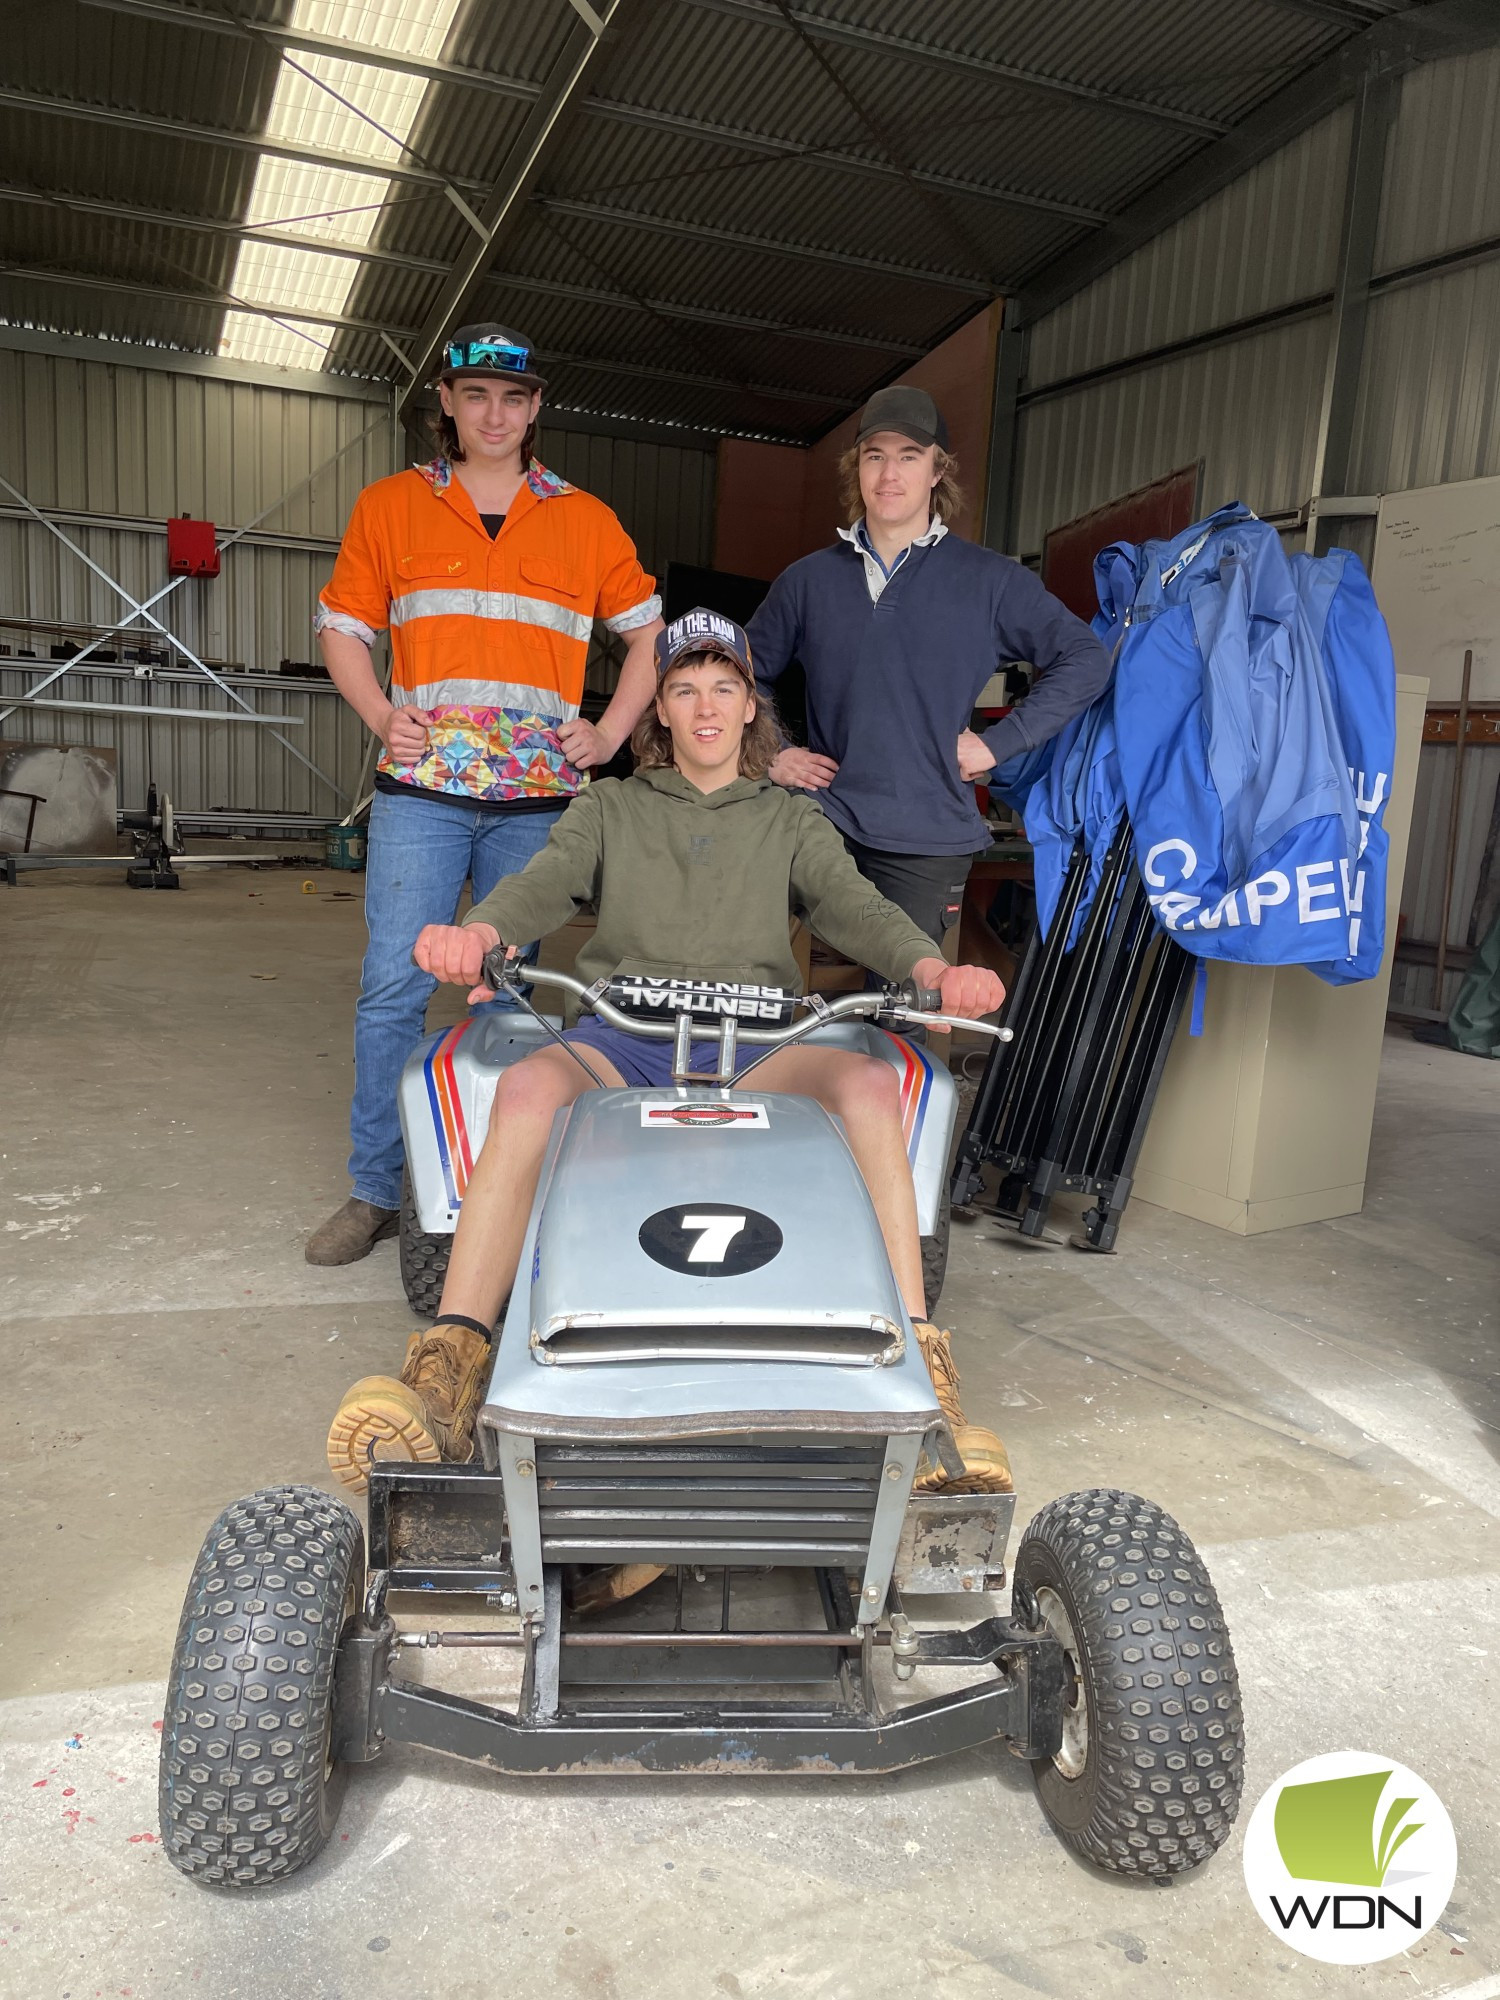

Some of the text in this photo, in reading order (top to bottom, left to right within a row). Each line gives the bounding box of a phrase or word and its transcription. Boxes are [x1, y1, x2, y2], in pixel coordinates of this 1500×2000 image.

[684, 612, 709, 633] THE
[709, 614, 736, 642] MAN
[622, 986, 783, 1020] RENTHAL
[681, 1215, 746, 1262] 7
